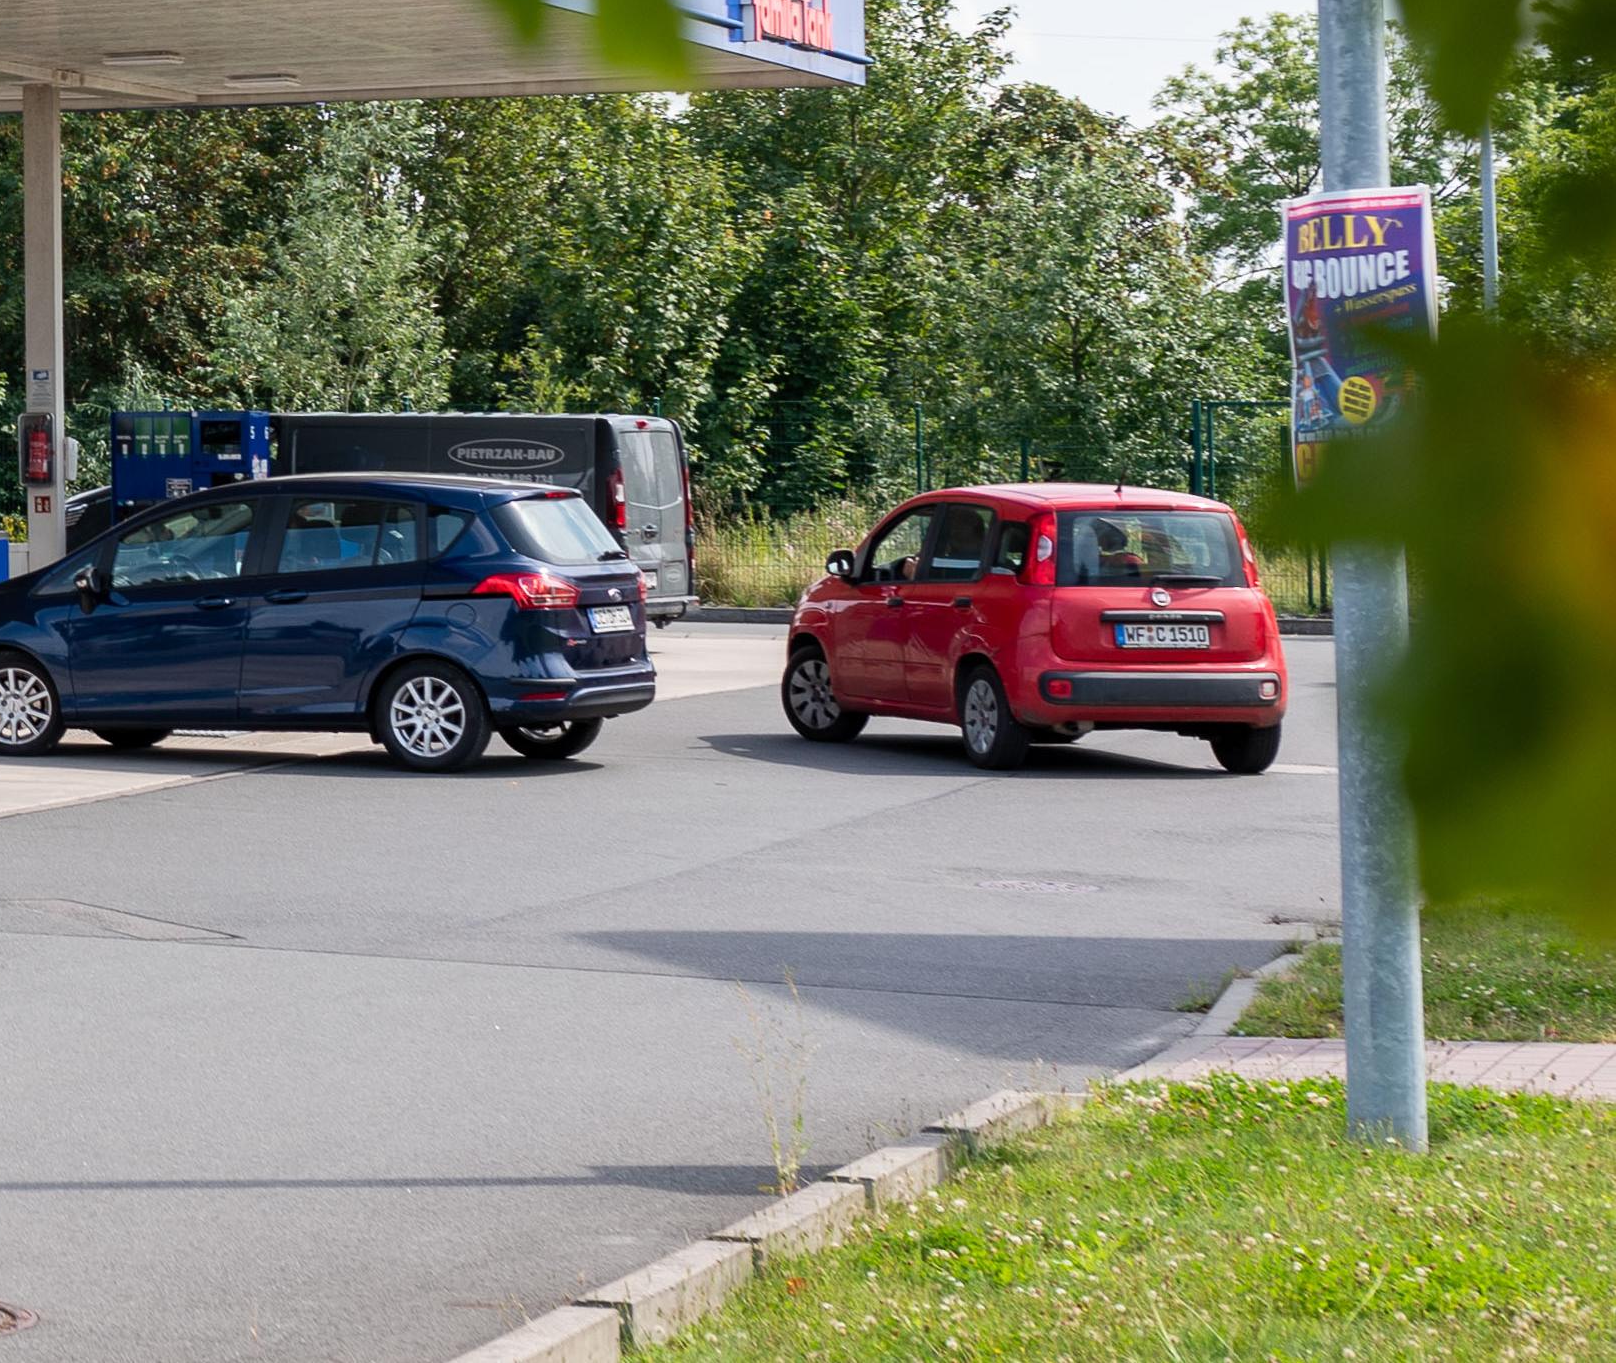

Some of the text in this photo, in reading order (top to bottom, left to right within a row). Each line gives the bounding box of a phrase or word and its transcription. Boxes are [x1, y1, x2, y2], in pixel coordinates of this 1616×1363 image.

[1297, 214, 1404, 254] BELLY
[1314, 249, 1411, 299] BOUNCE
[457, 448, 555, 460] PIETRZAK-BAU
[1125, 626, 1207, 643] WF C 1510
